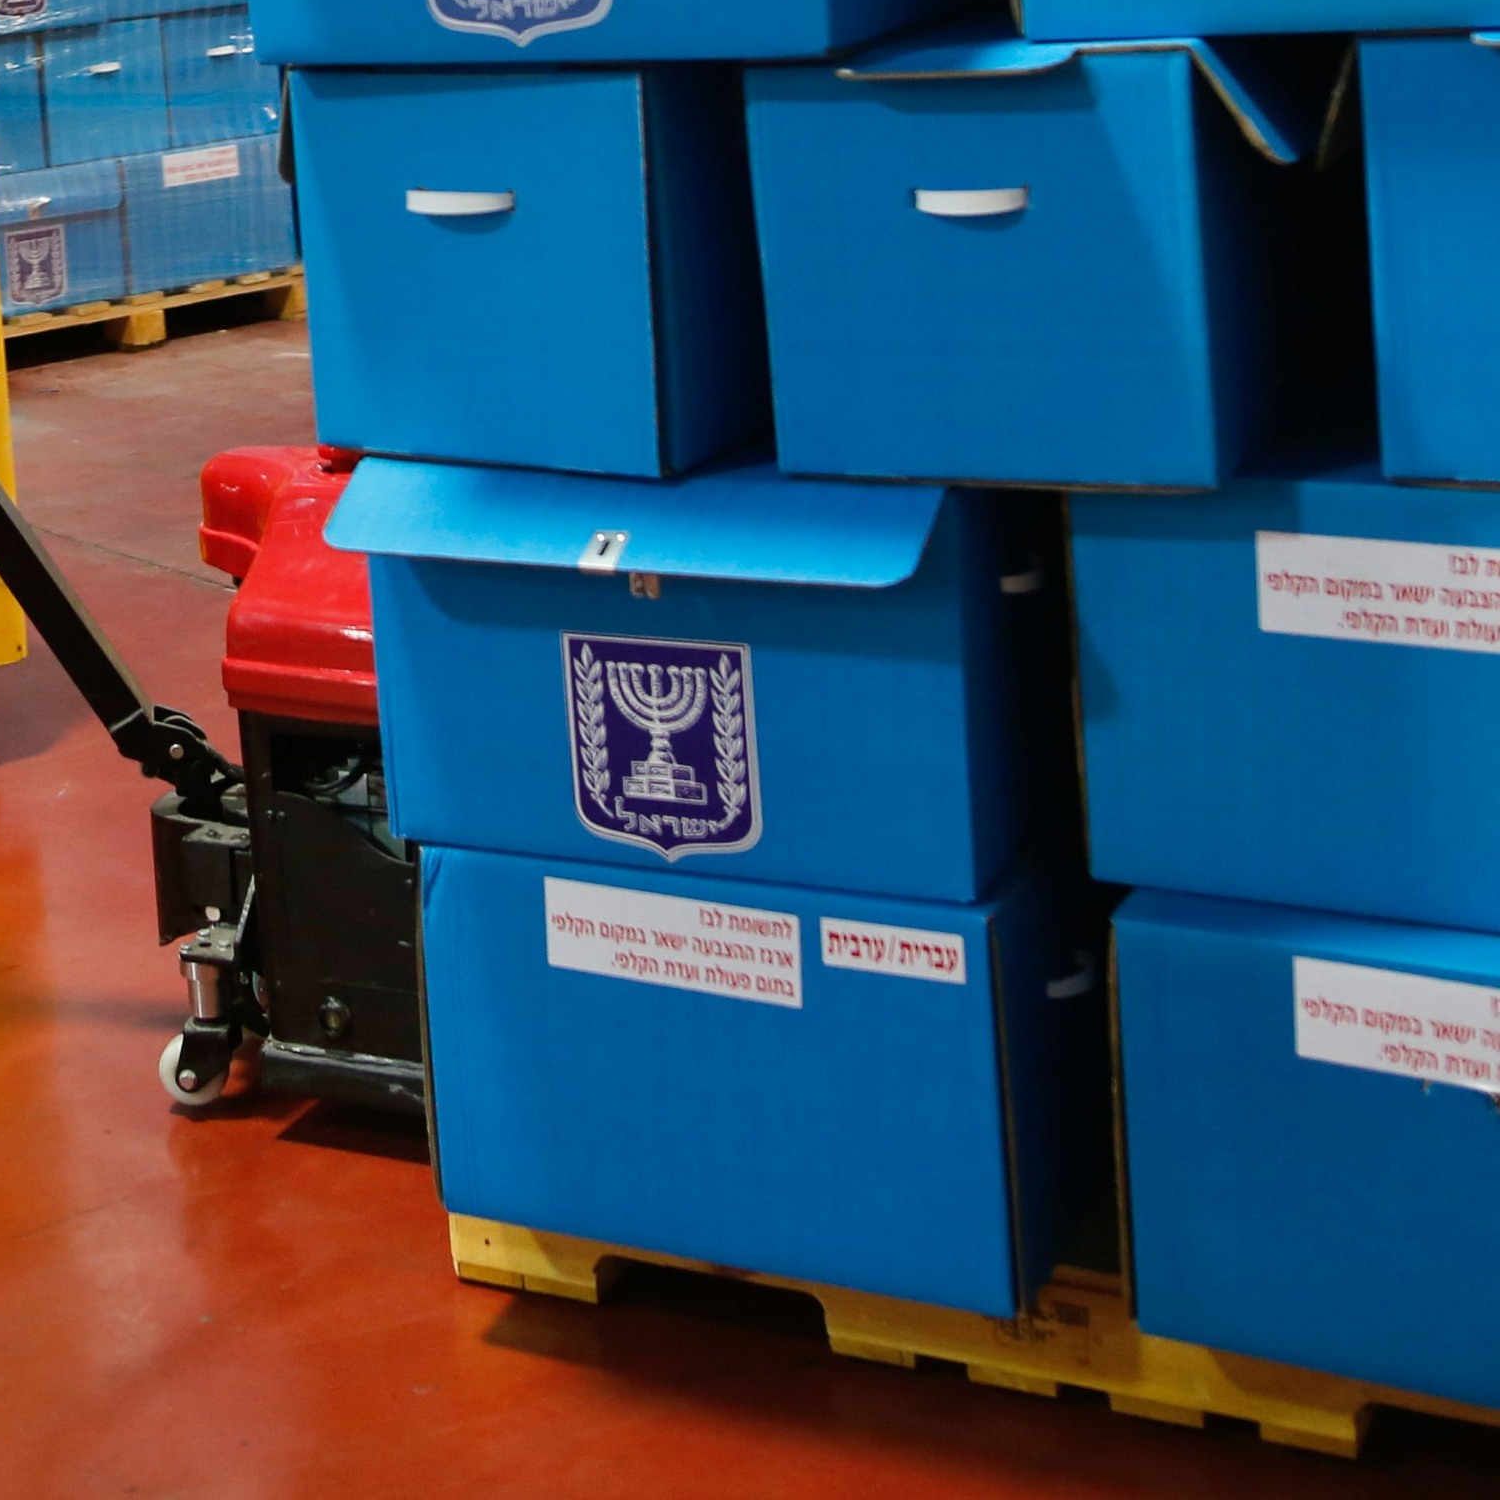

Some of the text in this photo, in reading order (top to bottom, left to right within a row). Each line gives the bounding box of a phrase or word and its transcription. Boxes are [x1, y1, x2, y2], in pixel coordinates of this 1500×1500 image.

[1265, 570, 1319, 596] הקלפי
[1324, 576, 1383, 601] במקום
[1405, 616, 1449, 639] ועדת
[1456, 617, 1500, 644] עולת
[614, 796, 719, 838] ישראל
[551, 911, 595, 937] הקלפי
[600, 921, 645, 943] במקום
[692, 936, 755, 962] ההצבעה
[759, 946, 793, 968] ארגז
[827, 931, 958, 973] עברית/ערבית
[664, 959, 700, 981] ועדת
[705, 963, 751, 990] פעולת
[756, 975, 794, 997] בתום
[1303, 996, 1358, 1025] הקלפי
[1363, 1008, 1423, 1035] במקום
